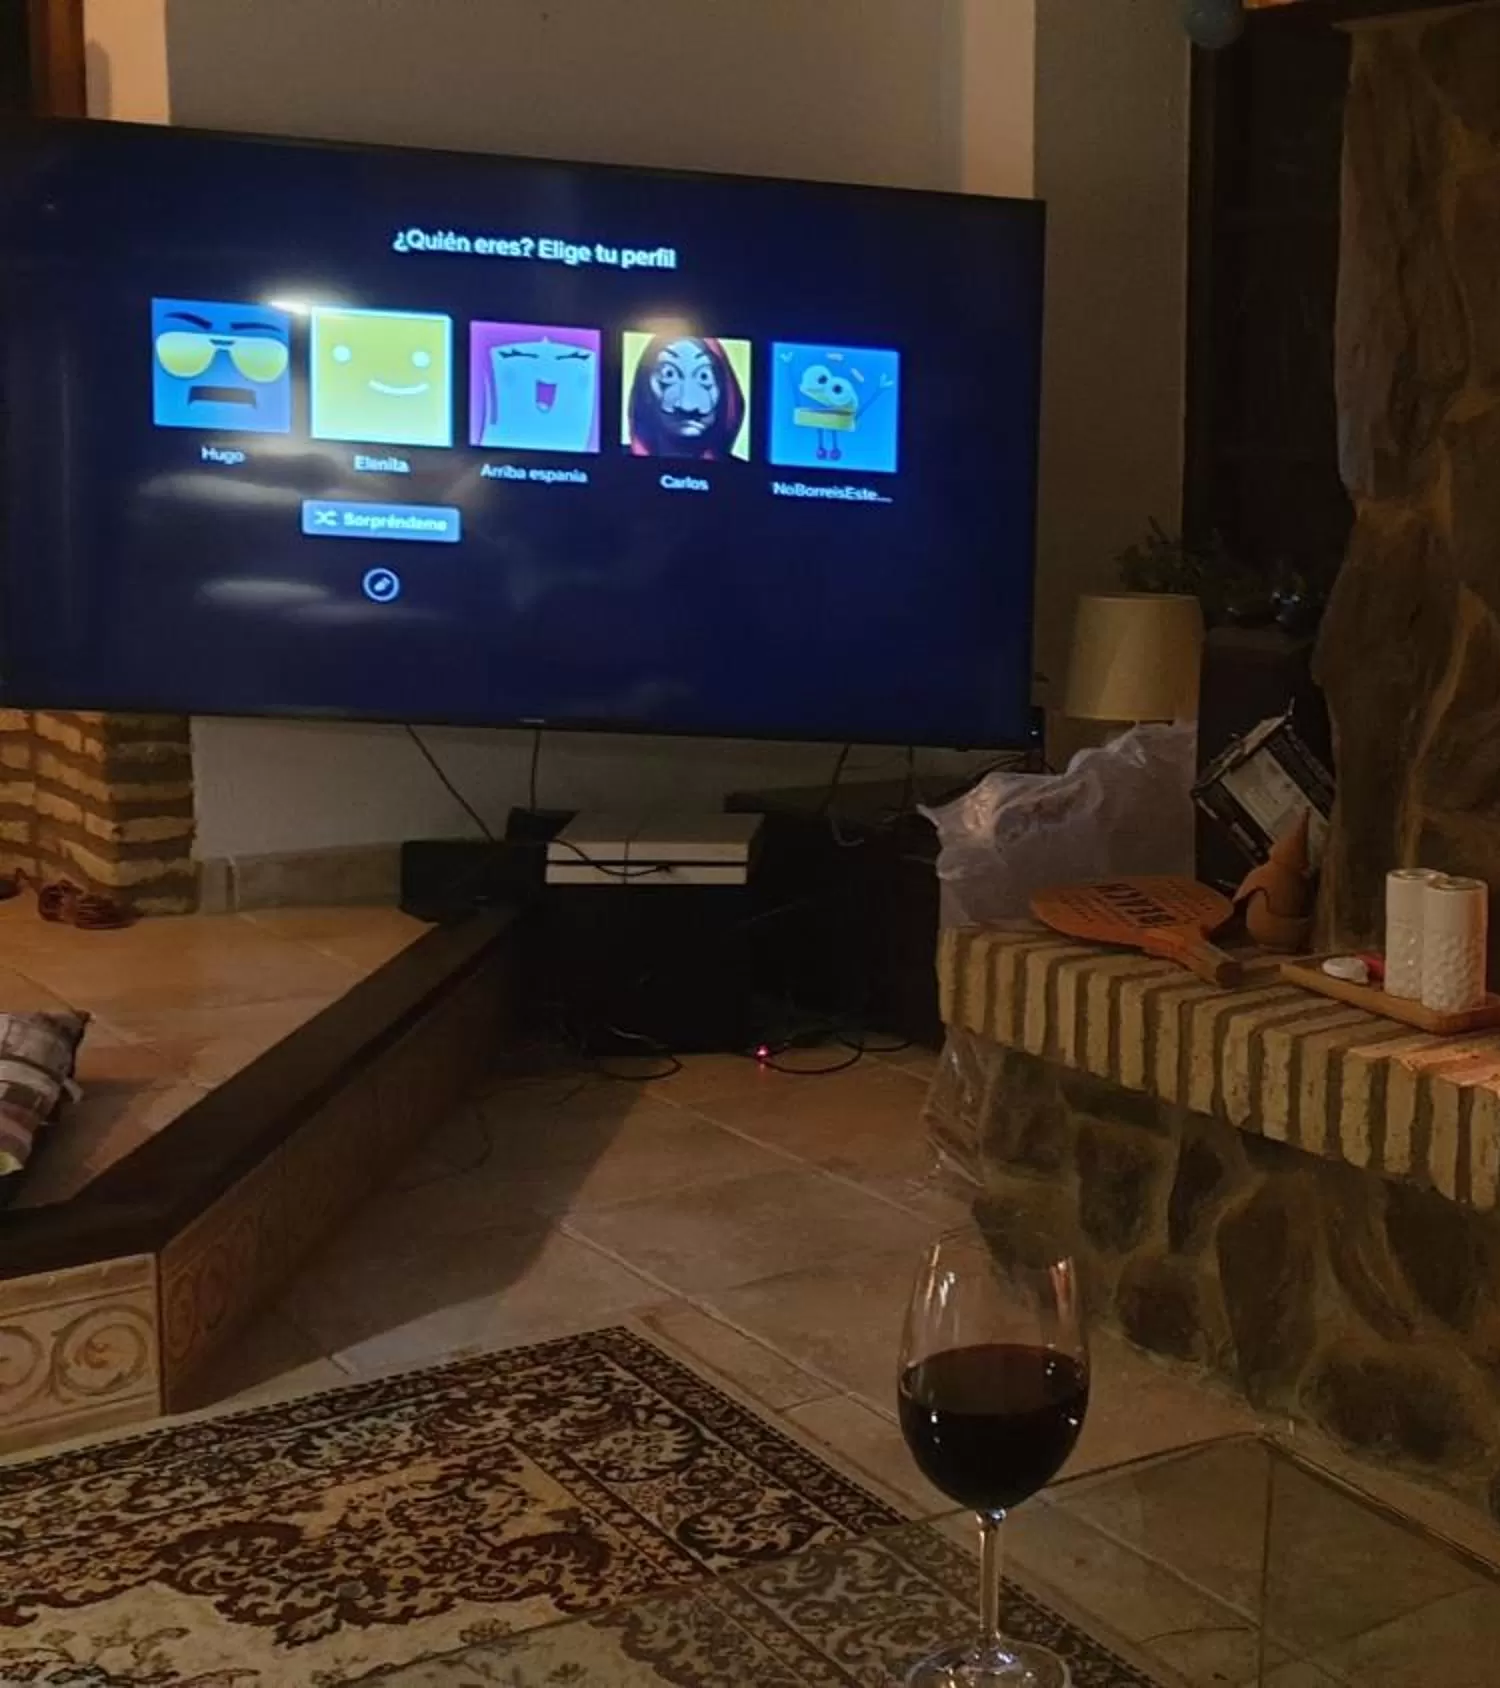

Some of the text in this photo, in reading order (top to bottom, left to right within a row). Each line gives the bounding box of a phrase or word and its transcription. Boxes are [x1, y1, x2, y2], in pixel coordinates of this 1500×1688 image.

[393, 228, 677, 268] ¿Quién eres? Elige tu perfil
[201, 446, 246, 465] Hugo
[481, 463, 527, 480] Arriba
[660, 475, 709, 491] Carlos
